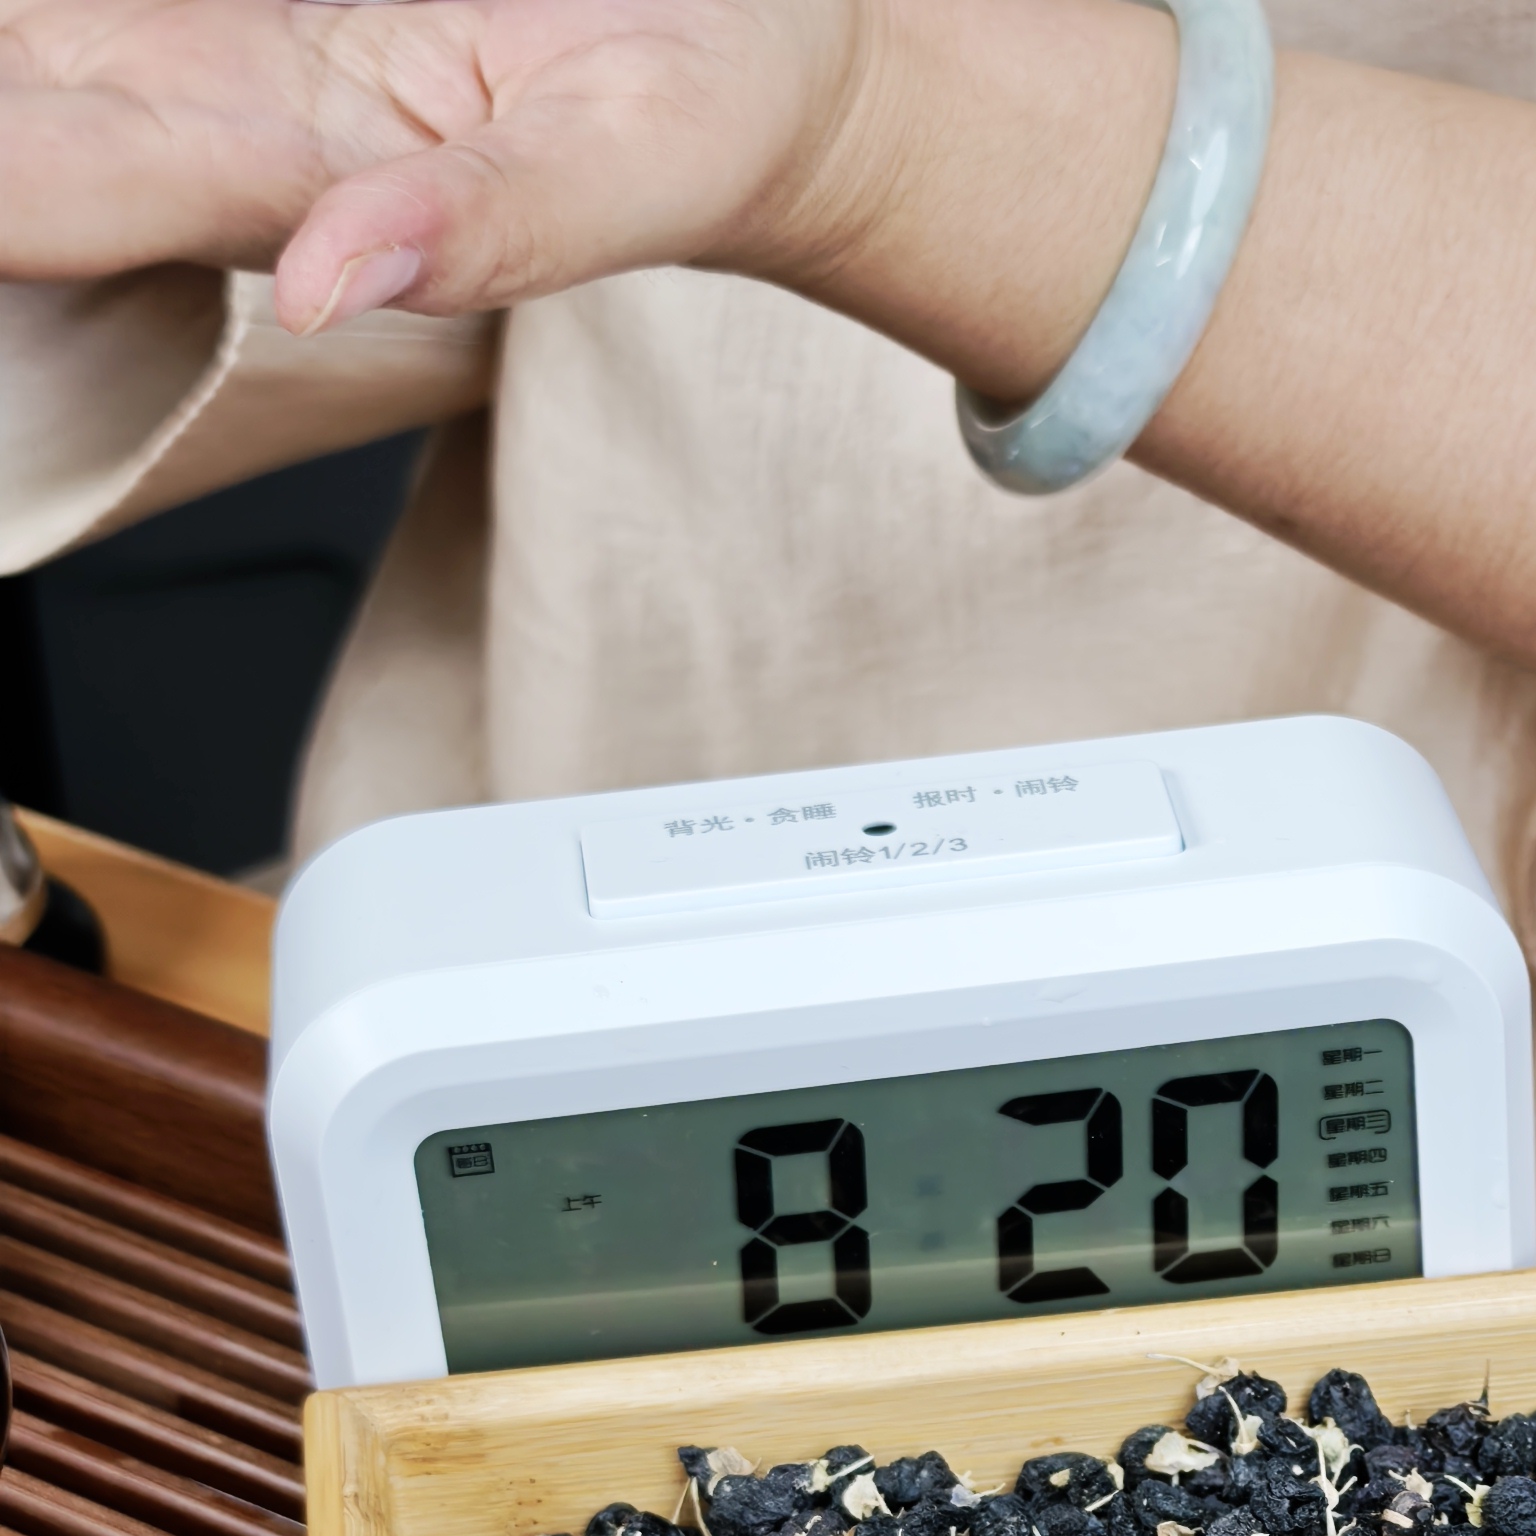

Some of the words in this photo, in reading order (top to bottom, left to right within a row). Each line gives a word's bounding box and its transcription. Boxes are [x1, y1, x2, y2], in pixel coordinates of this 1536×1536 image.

[805, 838, 968, 870] 闹铃1/2/3
[1322, 1047, 1383, 1065] 星期一
[1323, 1080, 1384, 1100] 星期二
[1326, 1114, 1386, 1134] 星期三
[1328, 1148, 1388, 1168] 星期四
[1329, 1181, 1389, 1202] 星期五
[561, 1194, 602, 1212] 上午
[1331, 1216, 1391, 1235] 星期六
[1332, 1249, 1391, 1268] 星期日
